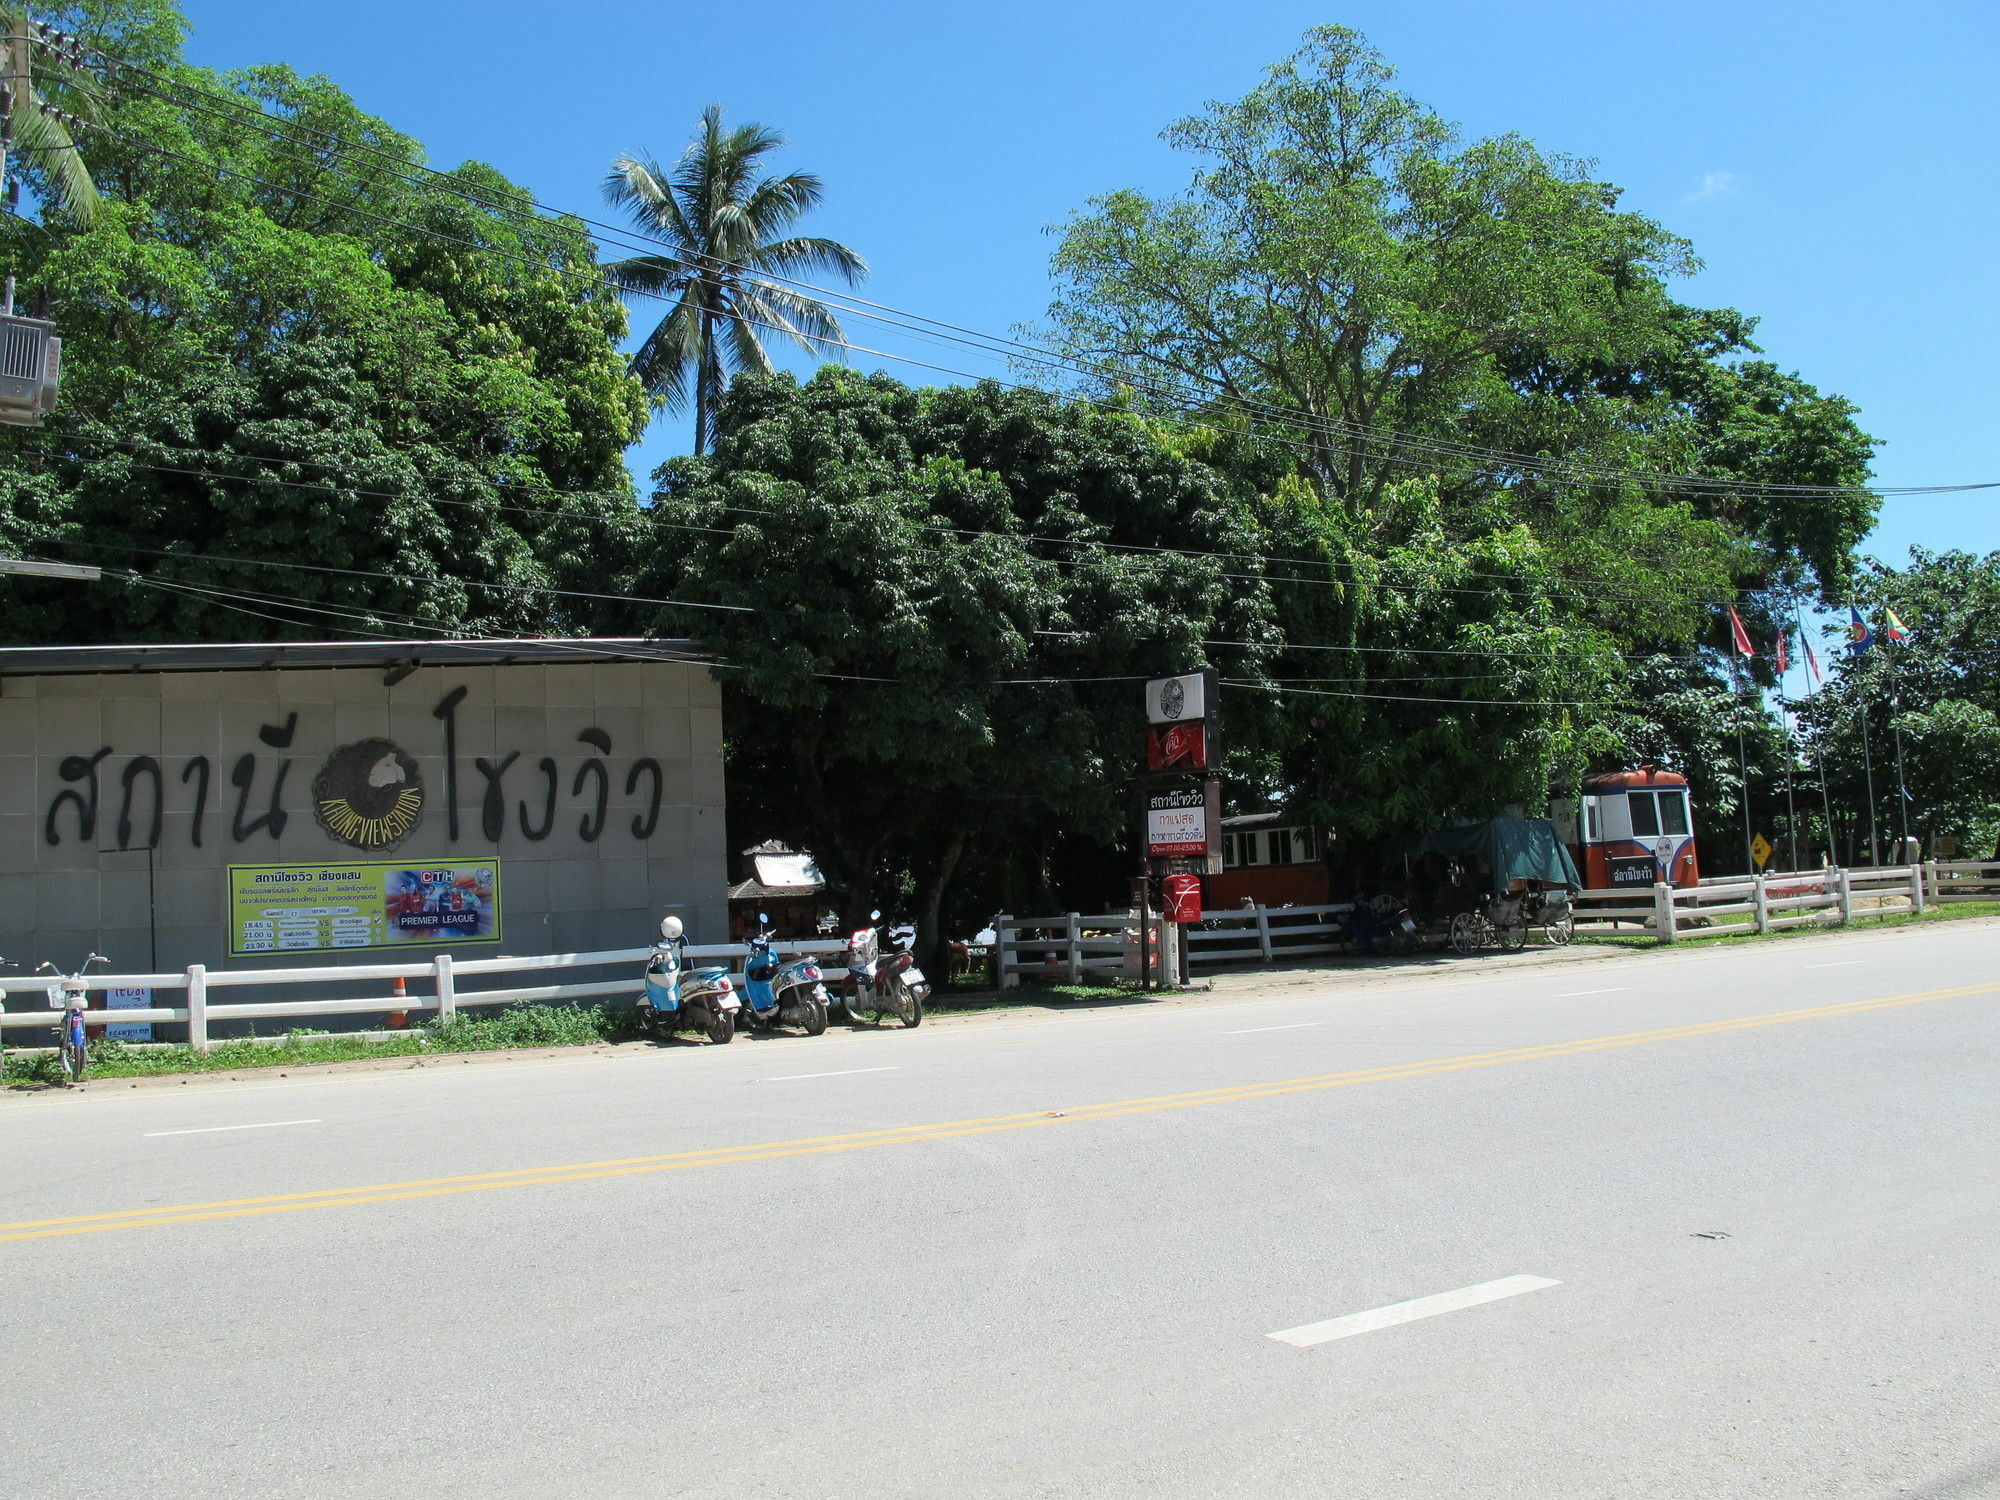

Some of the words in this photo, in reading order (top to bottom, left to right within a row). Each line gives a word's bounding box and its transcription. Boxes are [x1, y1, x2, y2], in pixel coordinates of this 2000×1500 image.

[1159, 812, 1195, 826] กาแฟสด
[1151, 844, 1166, 854] Open
[255, 871, 313, 883] สถานีโขงวิว
[318, 869, 361, 881] เชียงแสน
[422, 871, 454, 883] CTH
[401, 916, 439, 926] PREMIER
[442, 914, 476, 924] LEAGUE
[245, 942, 265, 950] 23.30
